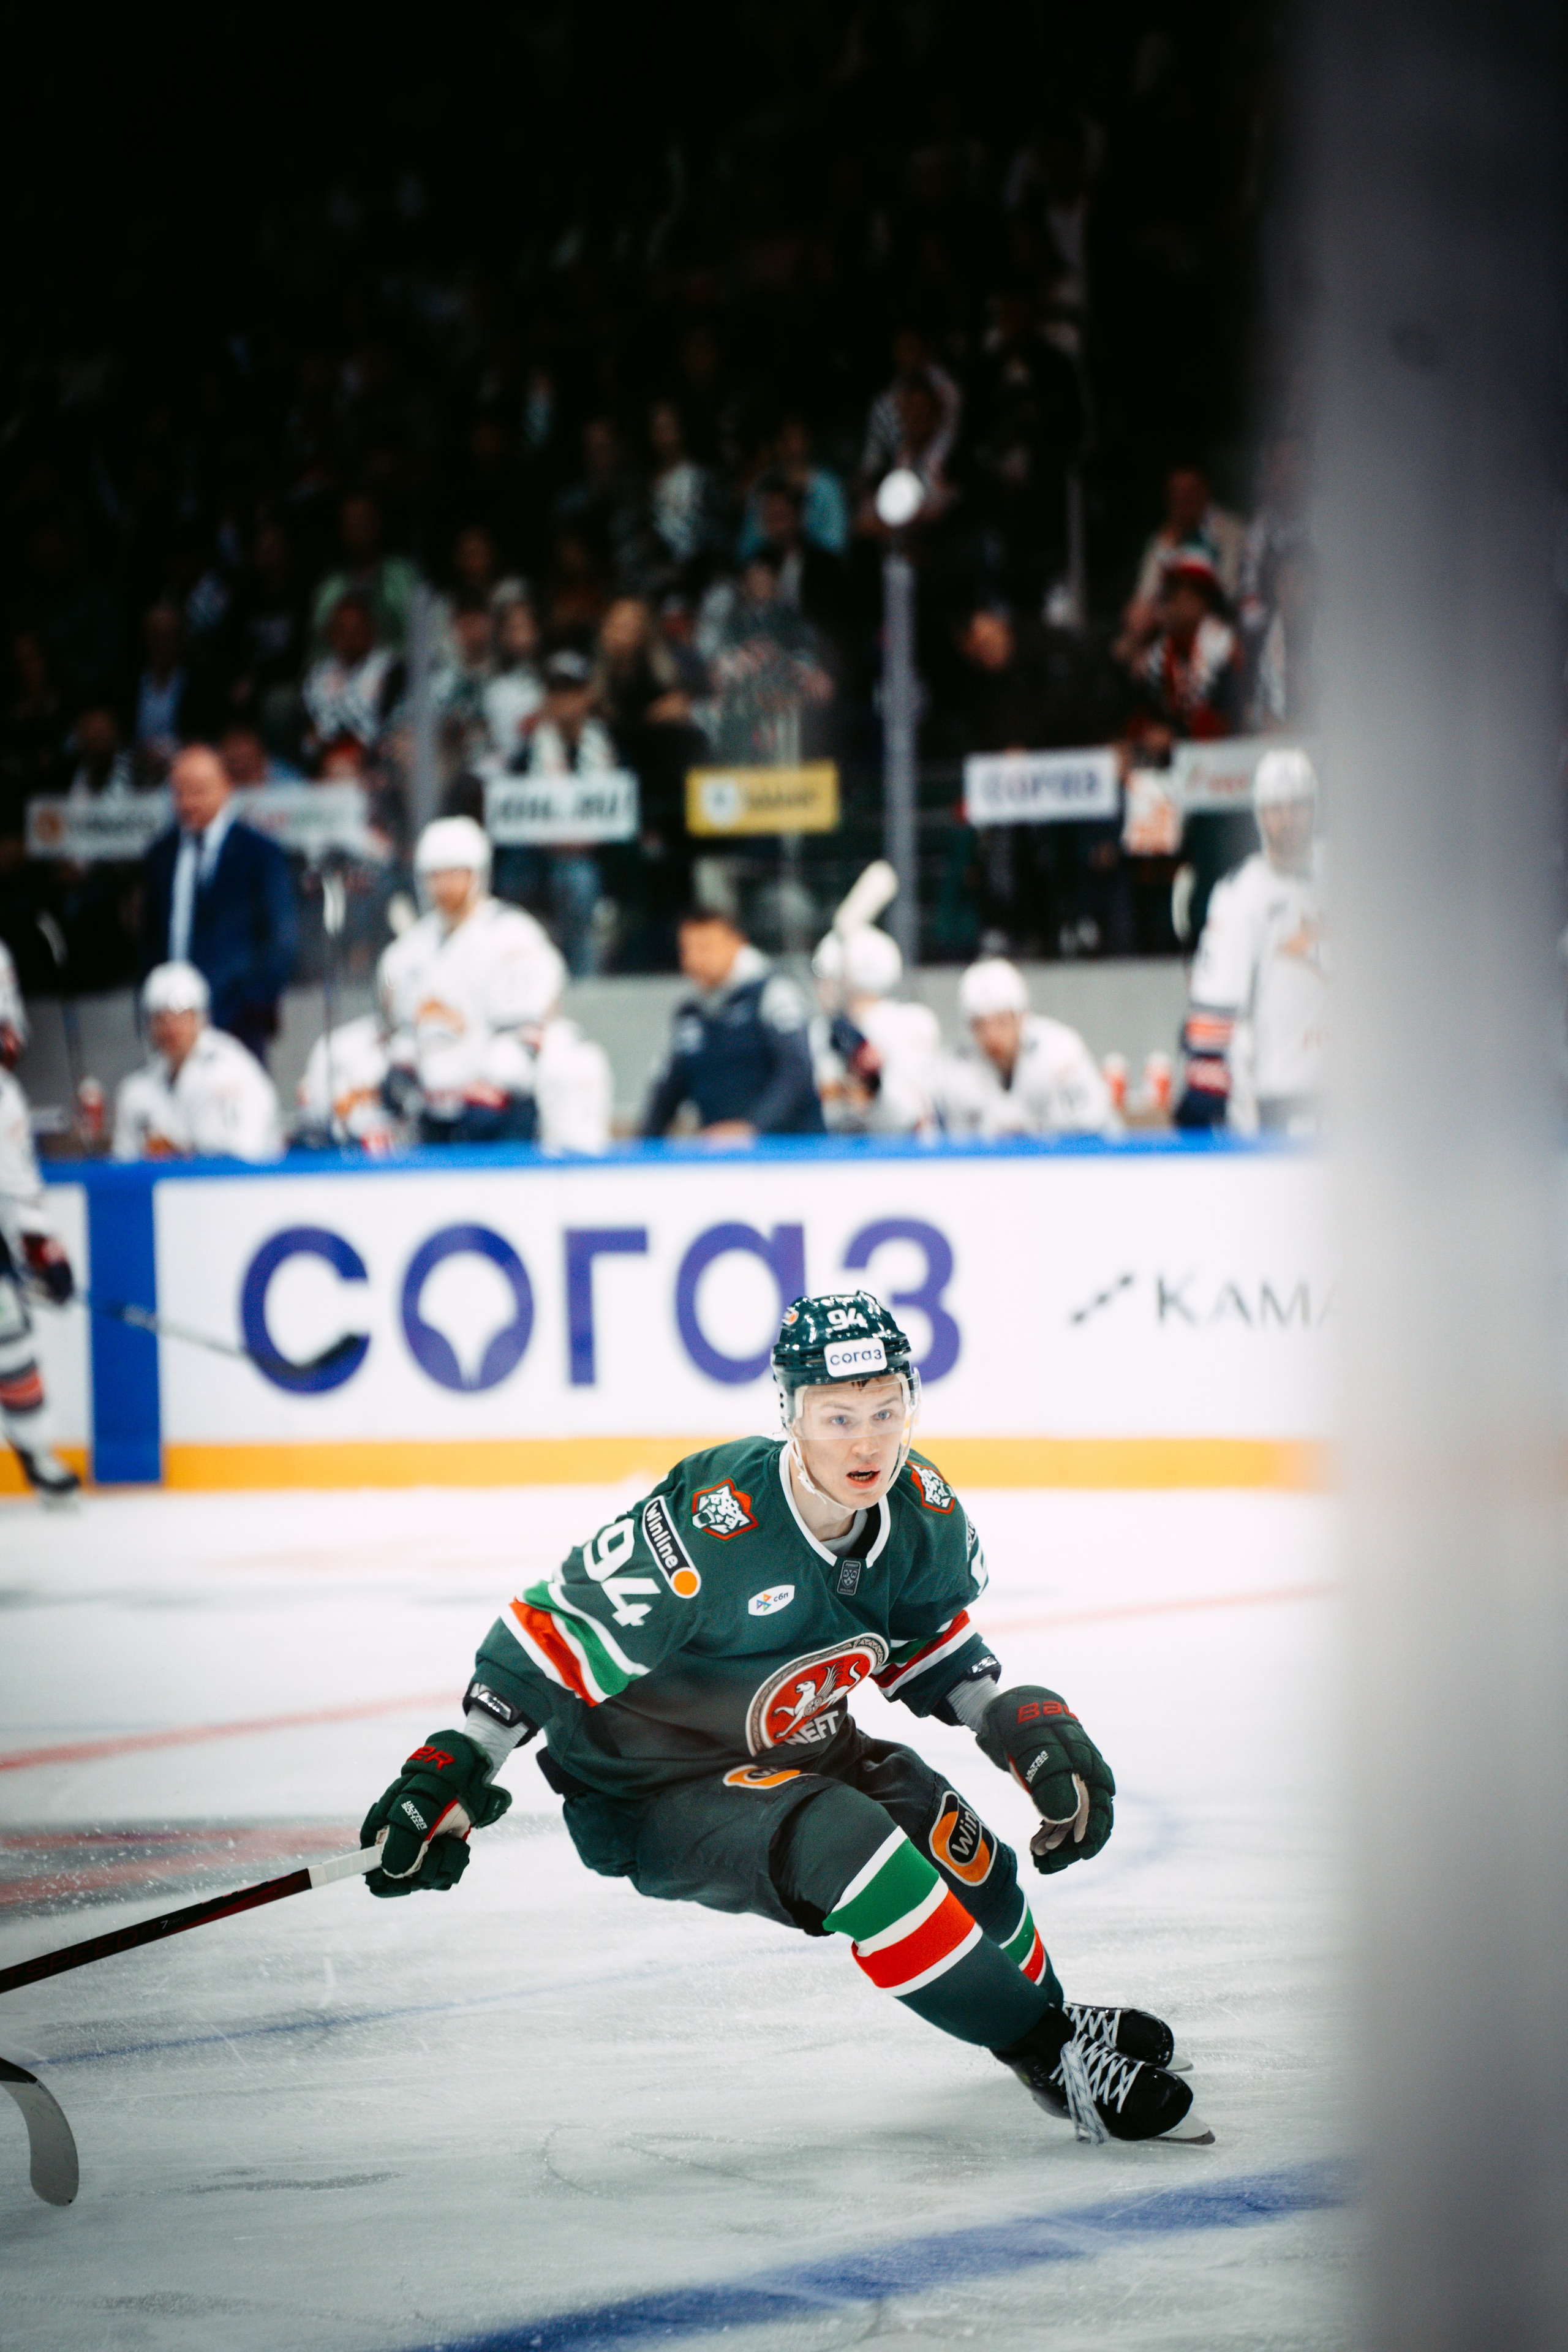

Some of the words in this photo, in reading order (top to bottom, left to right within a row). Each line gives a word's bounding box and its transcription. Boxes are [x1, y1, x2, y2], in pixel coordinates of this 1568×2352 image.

[241, 1218, 960, 1394] согаз
[827, 1308, 868, 1330] 94
[830, 1349, 882, 1365] согаз
[646, 1502, 678, 1569] Winline
[583, 1518, 662, 1627] 94
[774, 1593, 788, 1602] сбп
[401, 1803, 423, 1830] SONIC
[406, 1800, 428, 1828] ULTRA
